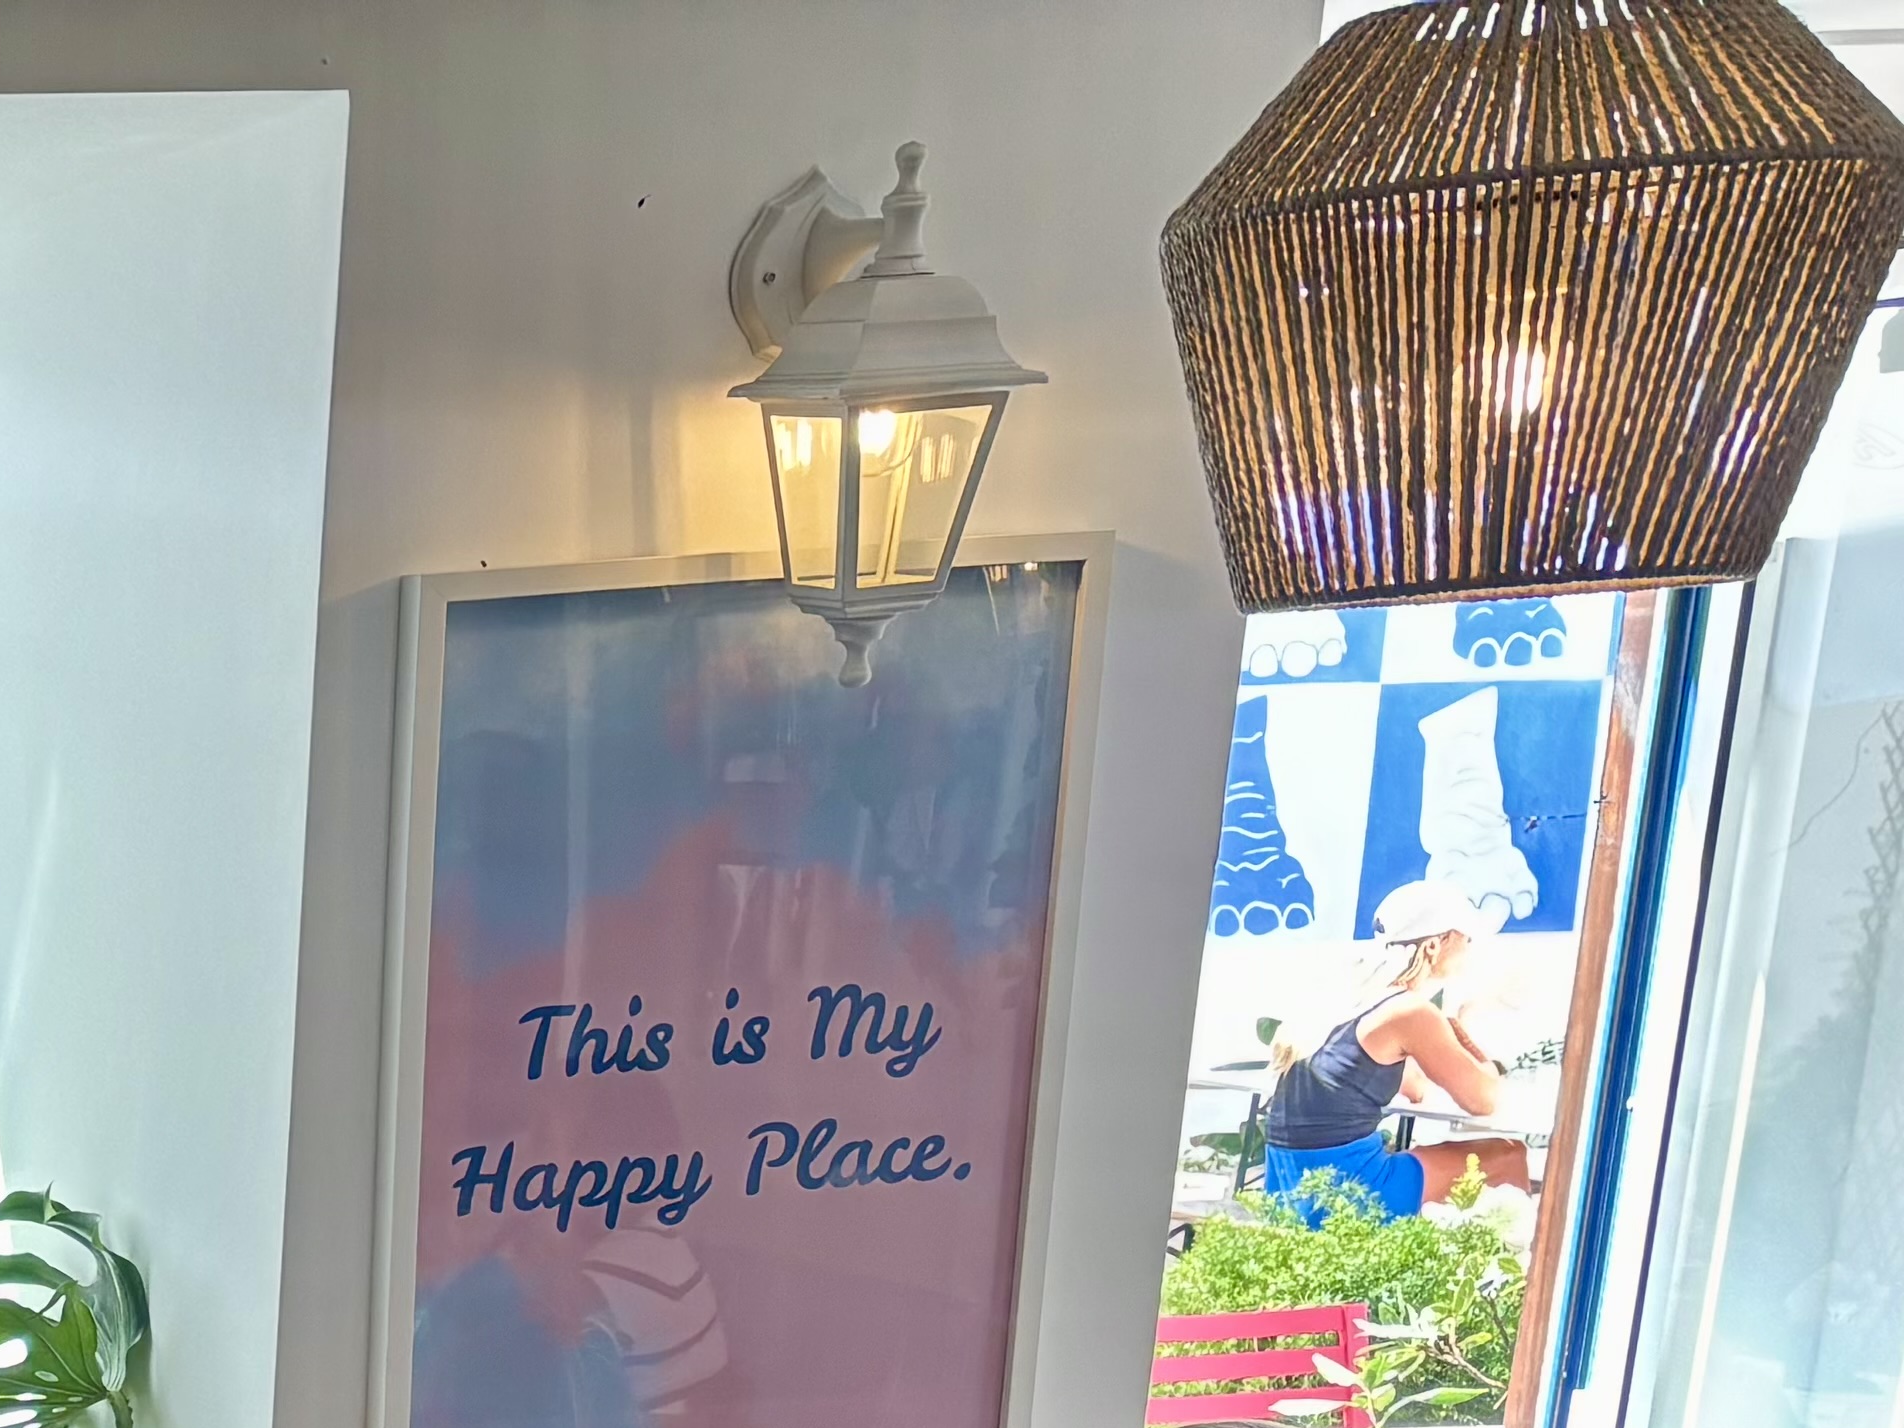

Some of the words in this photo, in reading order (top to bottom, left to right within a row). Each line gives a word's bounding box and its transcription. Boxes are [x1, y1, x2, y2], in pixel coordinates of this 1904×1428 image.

[518, 993, 675, 1081] This
[711, 987, 769, 1068] is
[805, 982, 942, 1079] My
[451, 1140, 713, 1233] Happy
[743, 1116, 974, 1198] Place.
